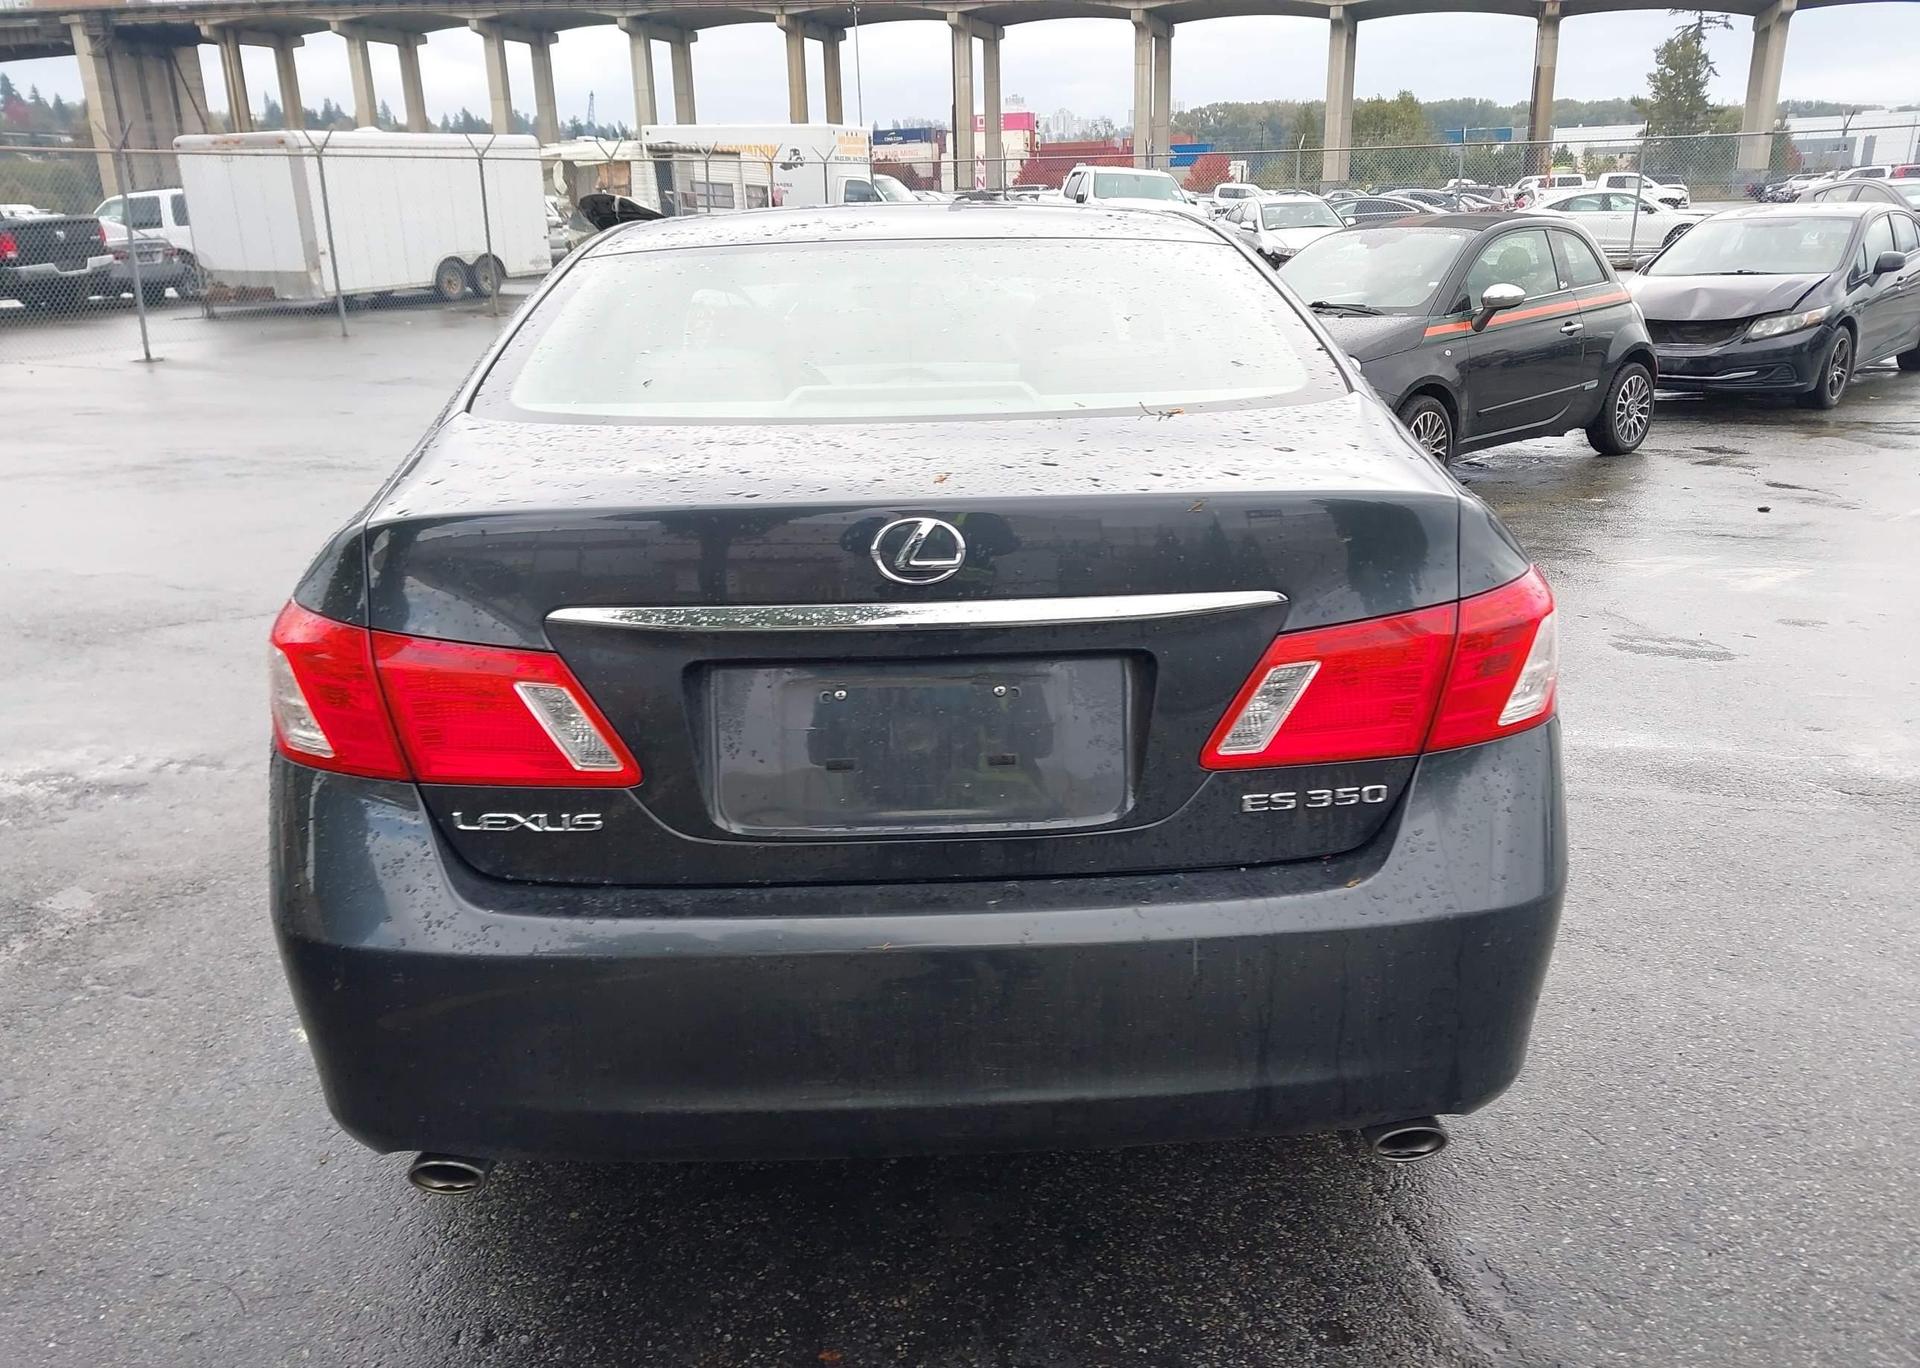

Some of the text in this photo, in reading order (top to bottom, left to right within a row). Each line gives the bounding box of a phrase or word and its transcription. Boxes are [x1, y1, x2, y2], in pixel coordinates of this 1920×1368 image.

[1241, 784, 1388, 812] ES 350
[451, 811, 603, 832] LEXUS
